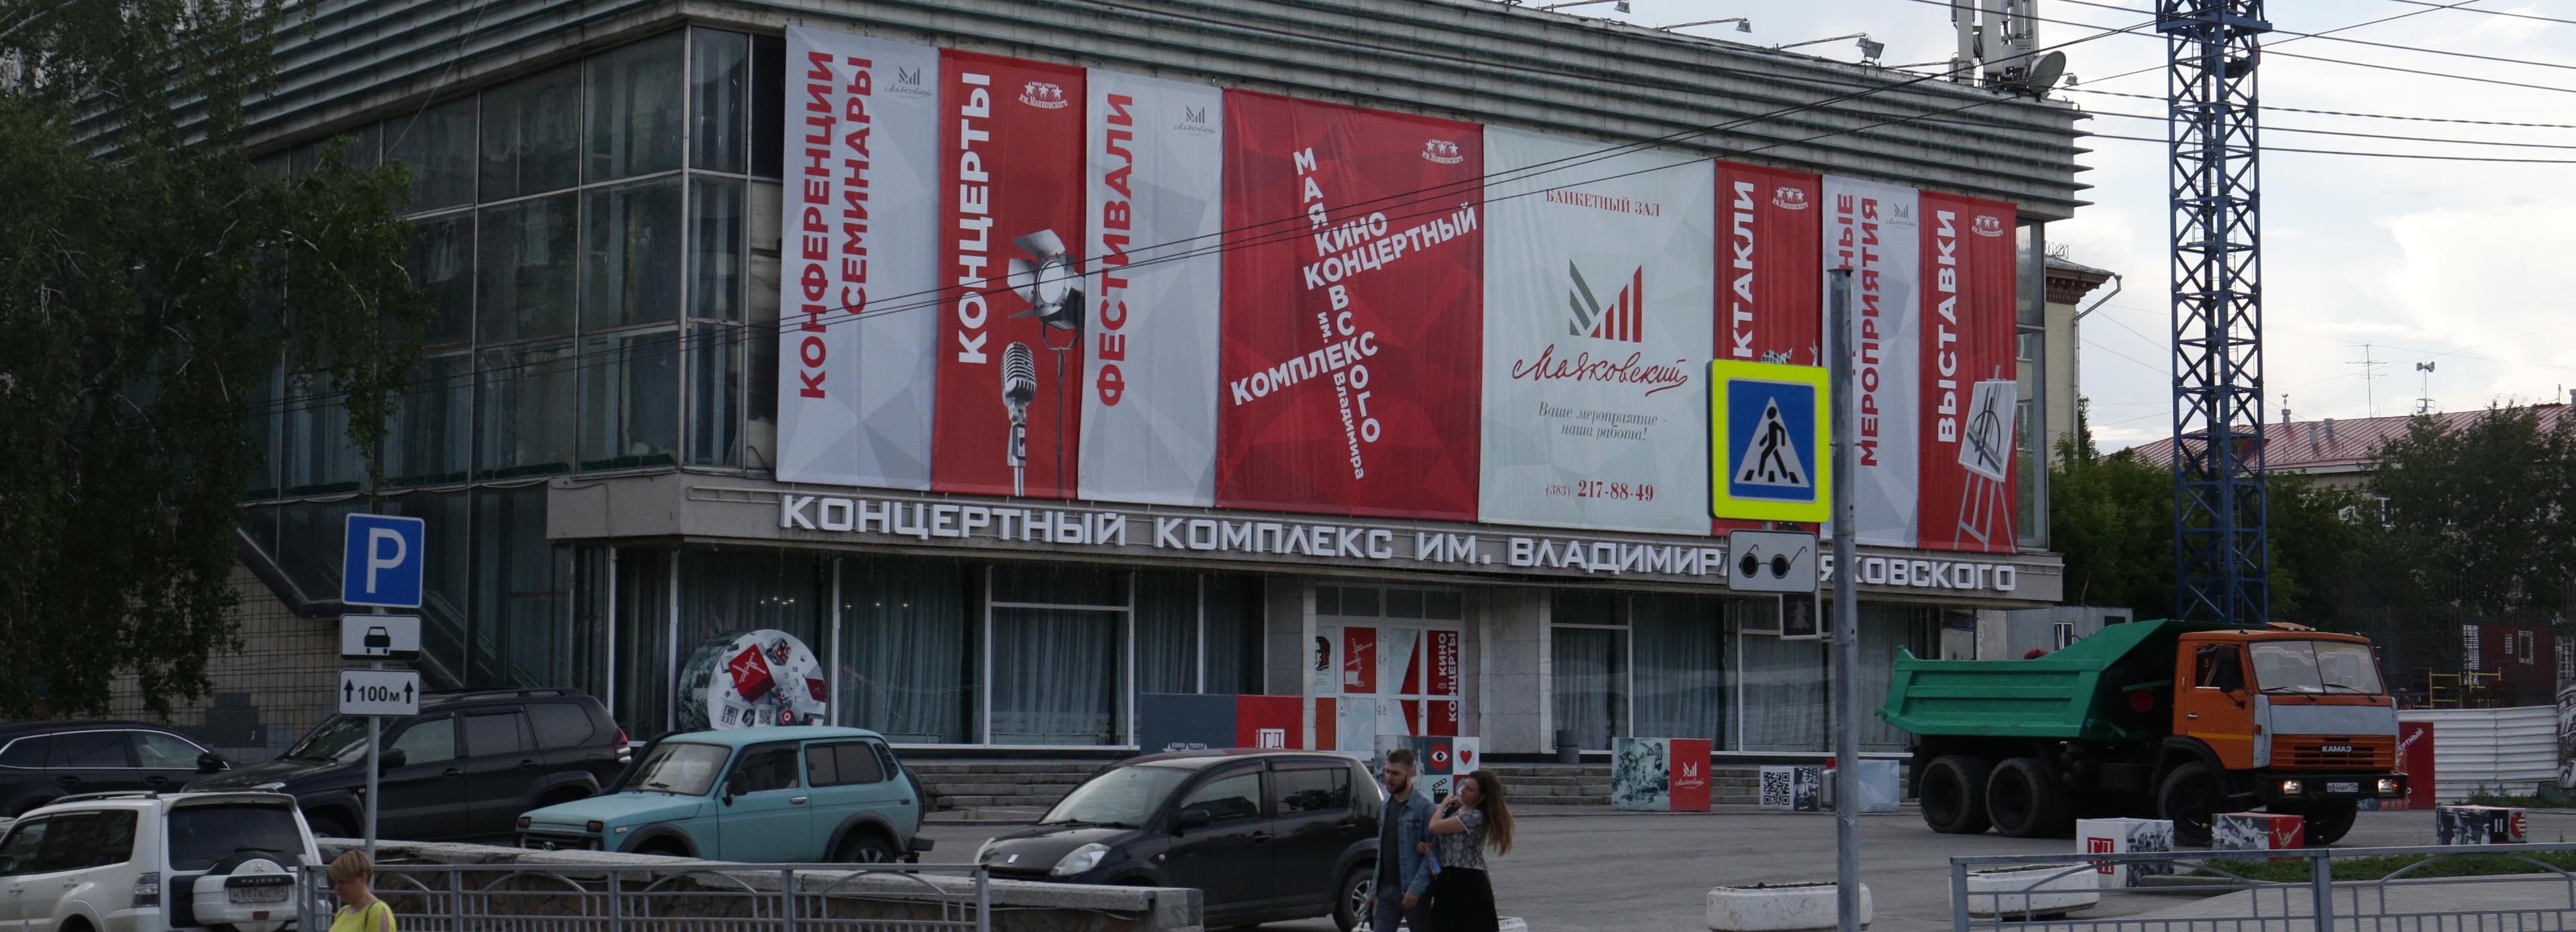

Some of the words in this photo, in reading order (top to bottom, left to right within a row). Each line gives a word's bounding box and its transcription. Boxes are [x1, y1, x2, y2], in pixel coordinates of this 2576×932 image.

[841, 57, 872, 315] СЕМИНАРЫ
[958, 72, 993, 364] КОНЦЕРТЫ
[1546, 188, 1630, 213] БАНКЕТНЫЙ
[1635, 200, 1661, 217] ЗАЛ
[800, 52, 837, 399] КОНФЕРЕНЦИИ
[1096, 93, 1133, 407] ФЕСТИВАЛИ
[1303, 201, 1478, 290] КОНЦЕРТНЫЙ
[1313, 211, 1388, 257] КИНО
[1733, 181, 1754, 359] КТАКЛИ
[1317, 311, 1332, 344] им.
[1860, 198, 1879, 466] МЕРОПРИЯТИЯ
[1937, 210, 1956, 443] ВЫСТАВКИ
[1230, 331, 1379, 406] КОМПЛЕКС
[1512, 343, 1688, 397] Маяковский
[1538, 402, 1572, 418] Ваше
[1576, 408, 1658, 426] мероприятие
[1561, 424, 1593, 436] наша
[1596, 424, 1648, 441] работа!
[1546, 483, 1570, 499] (383)
[1578, 479, 1654, 502] 217-88-49
[781, 496, 1126, 546] КОНЦЕРТНЫЙ
[1156, 517, 1393, 560] КОМПЛЕКС
[1415, 532, 1492, 565] ИМ.
[1509, 537, 1727, 576] ВЛАДИМИР
[1820, 555, 2017, 591] ЯОВСКОГО
[1438, 633, 1447, 676] КИНО
[1448, 633, 1457, 722] КОНЦЕРТЫ
[2322, 745, 2352, 753] КАМАЗ
[2399, 727, 2424, 751] ЕРТНЫЙ
